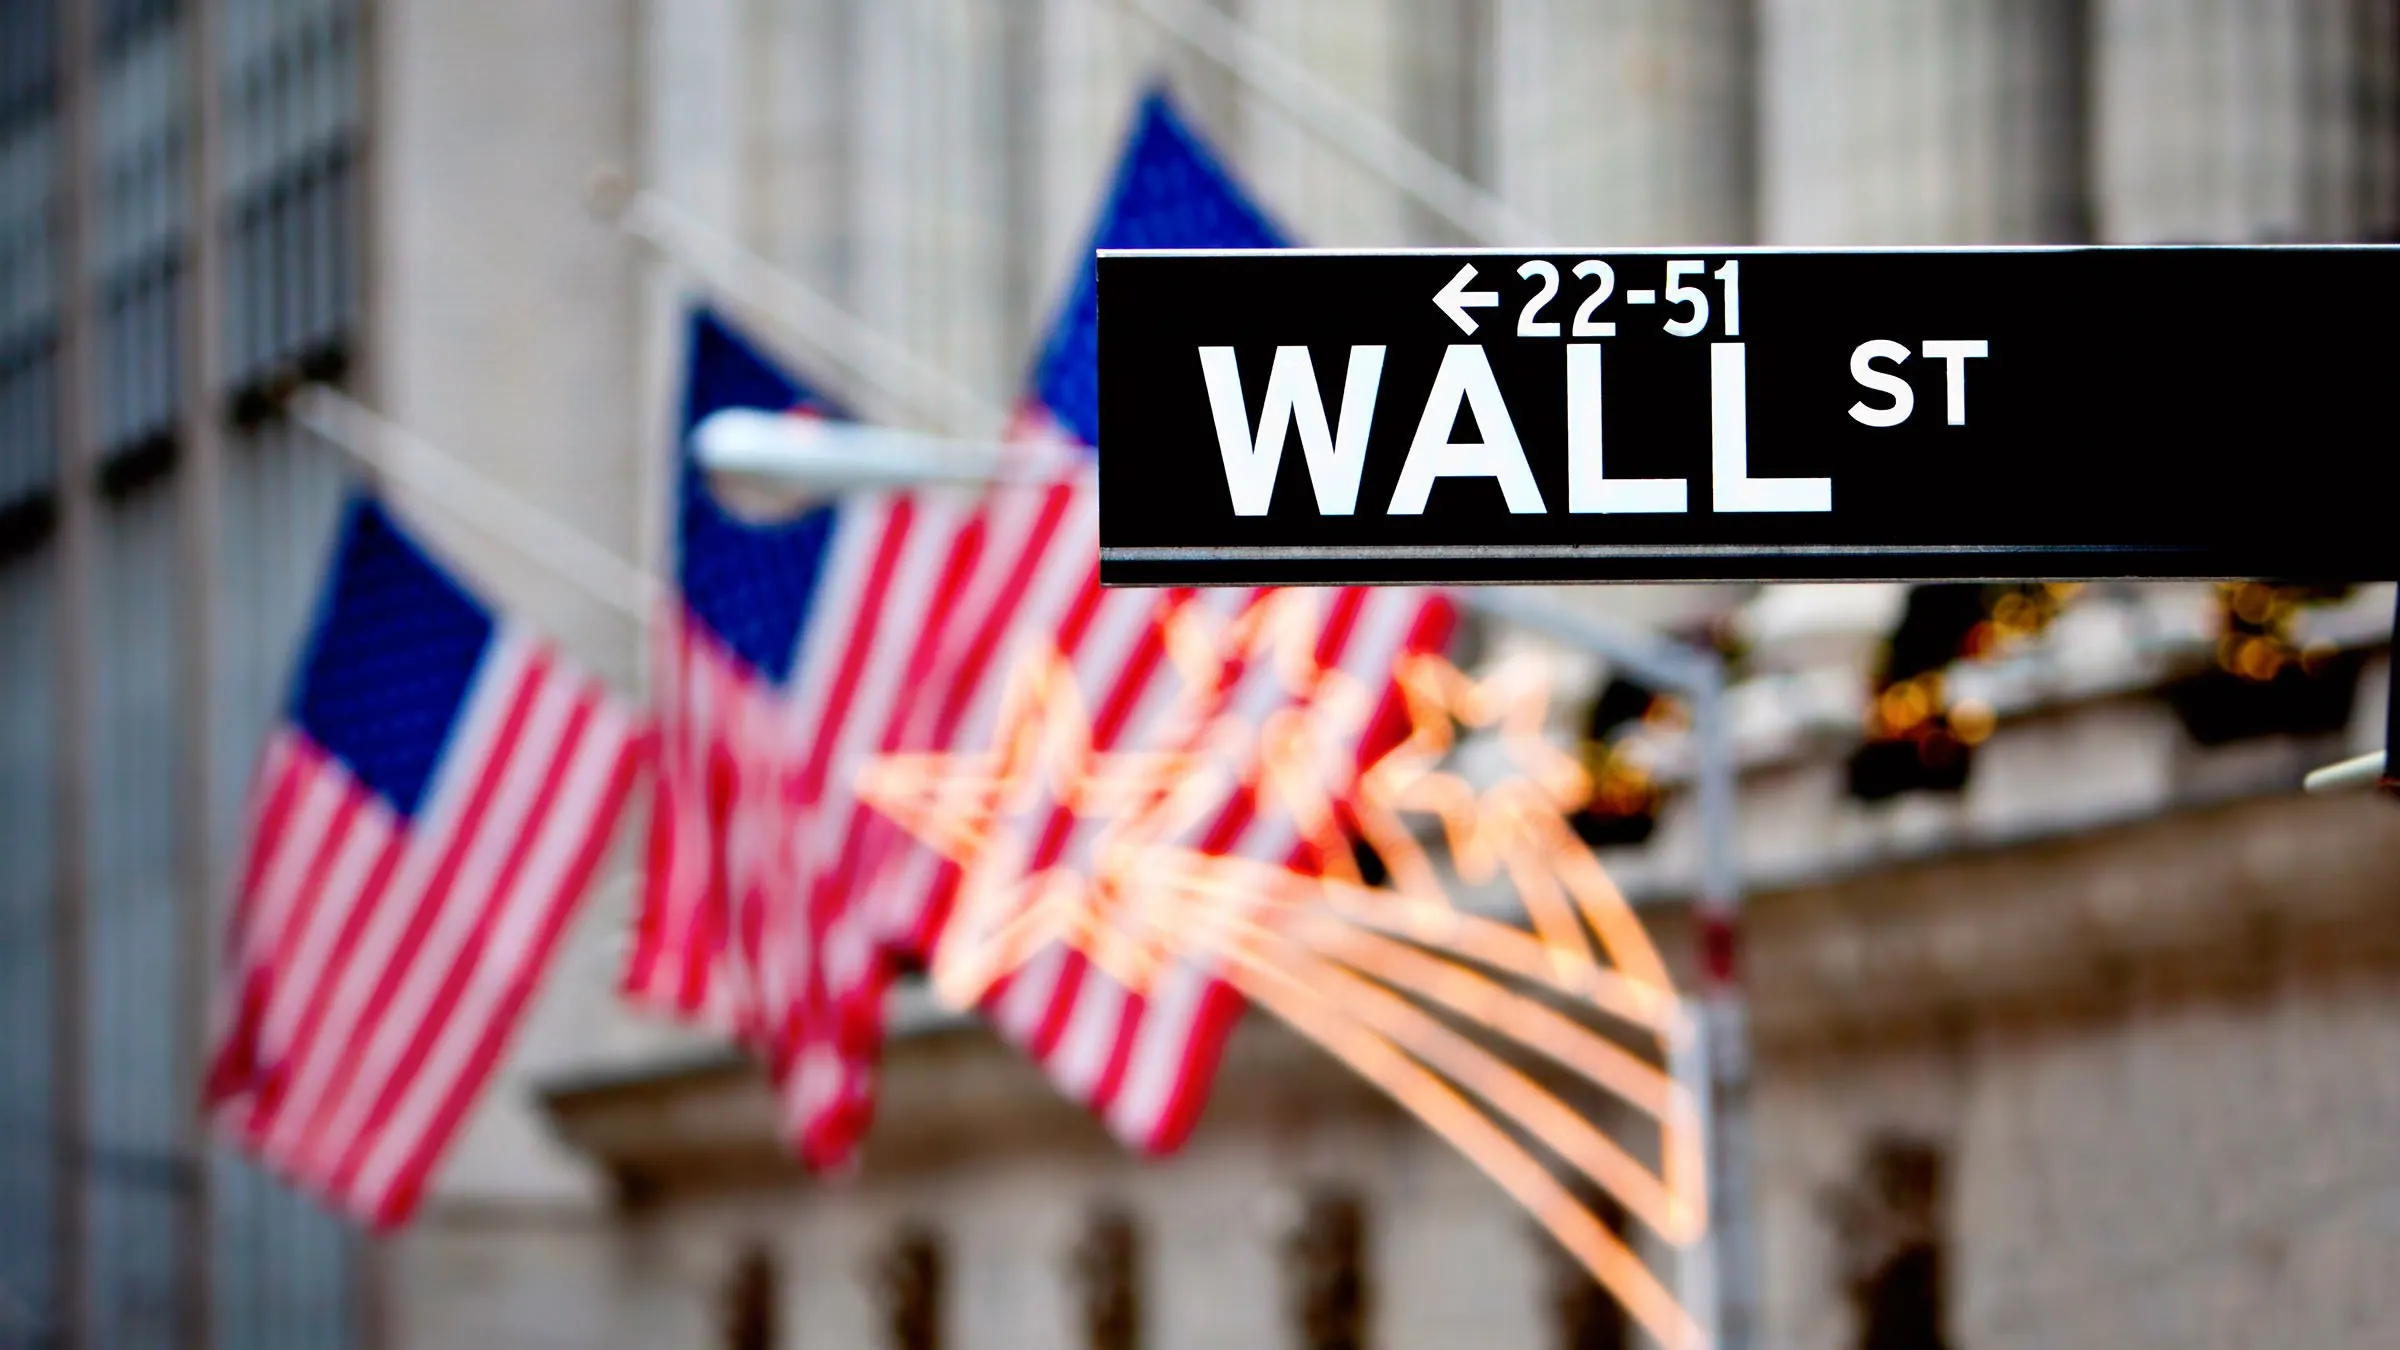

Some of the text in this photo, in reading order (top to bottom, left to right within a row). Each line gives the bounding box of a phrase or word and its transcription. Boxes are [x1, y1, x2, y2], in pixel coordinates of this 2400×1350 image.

[1516, 259, 1741, 337] 22-51
[1197, 339, 1989, 517] WALL ST
